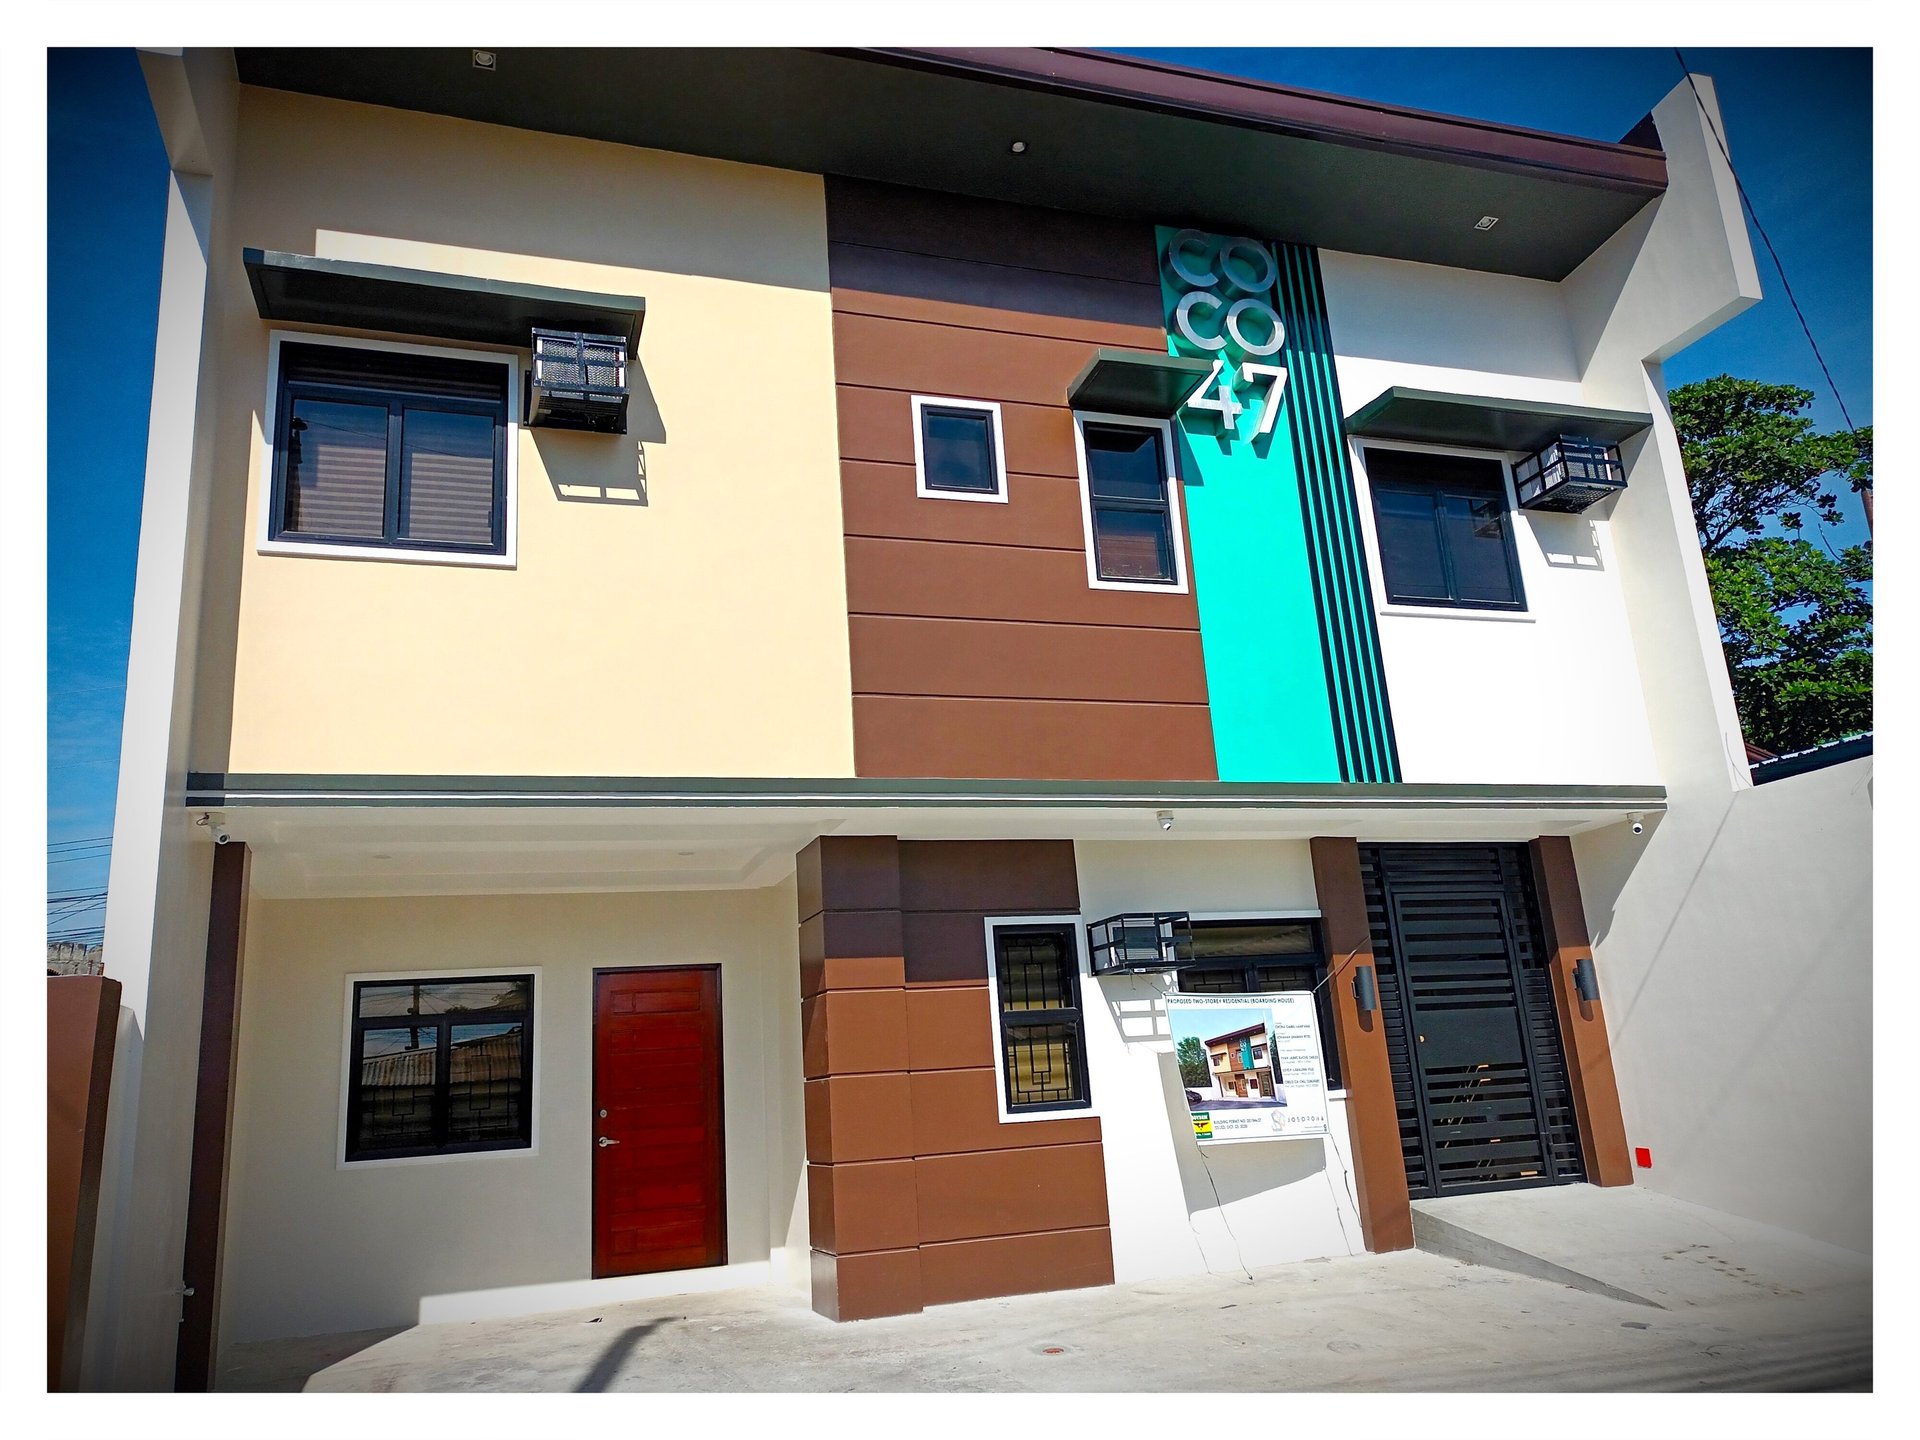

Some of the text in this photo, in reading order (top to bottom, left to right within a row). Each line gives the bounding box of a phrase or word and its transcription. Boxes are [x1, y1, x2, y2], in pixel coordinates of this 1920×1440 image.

[1168, 228, 1276, 293] CO
[1176, 290, 1286, 356] CO
[1187, 359, 1288, 434] 47
